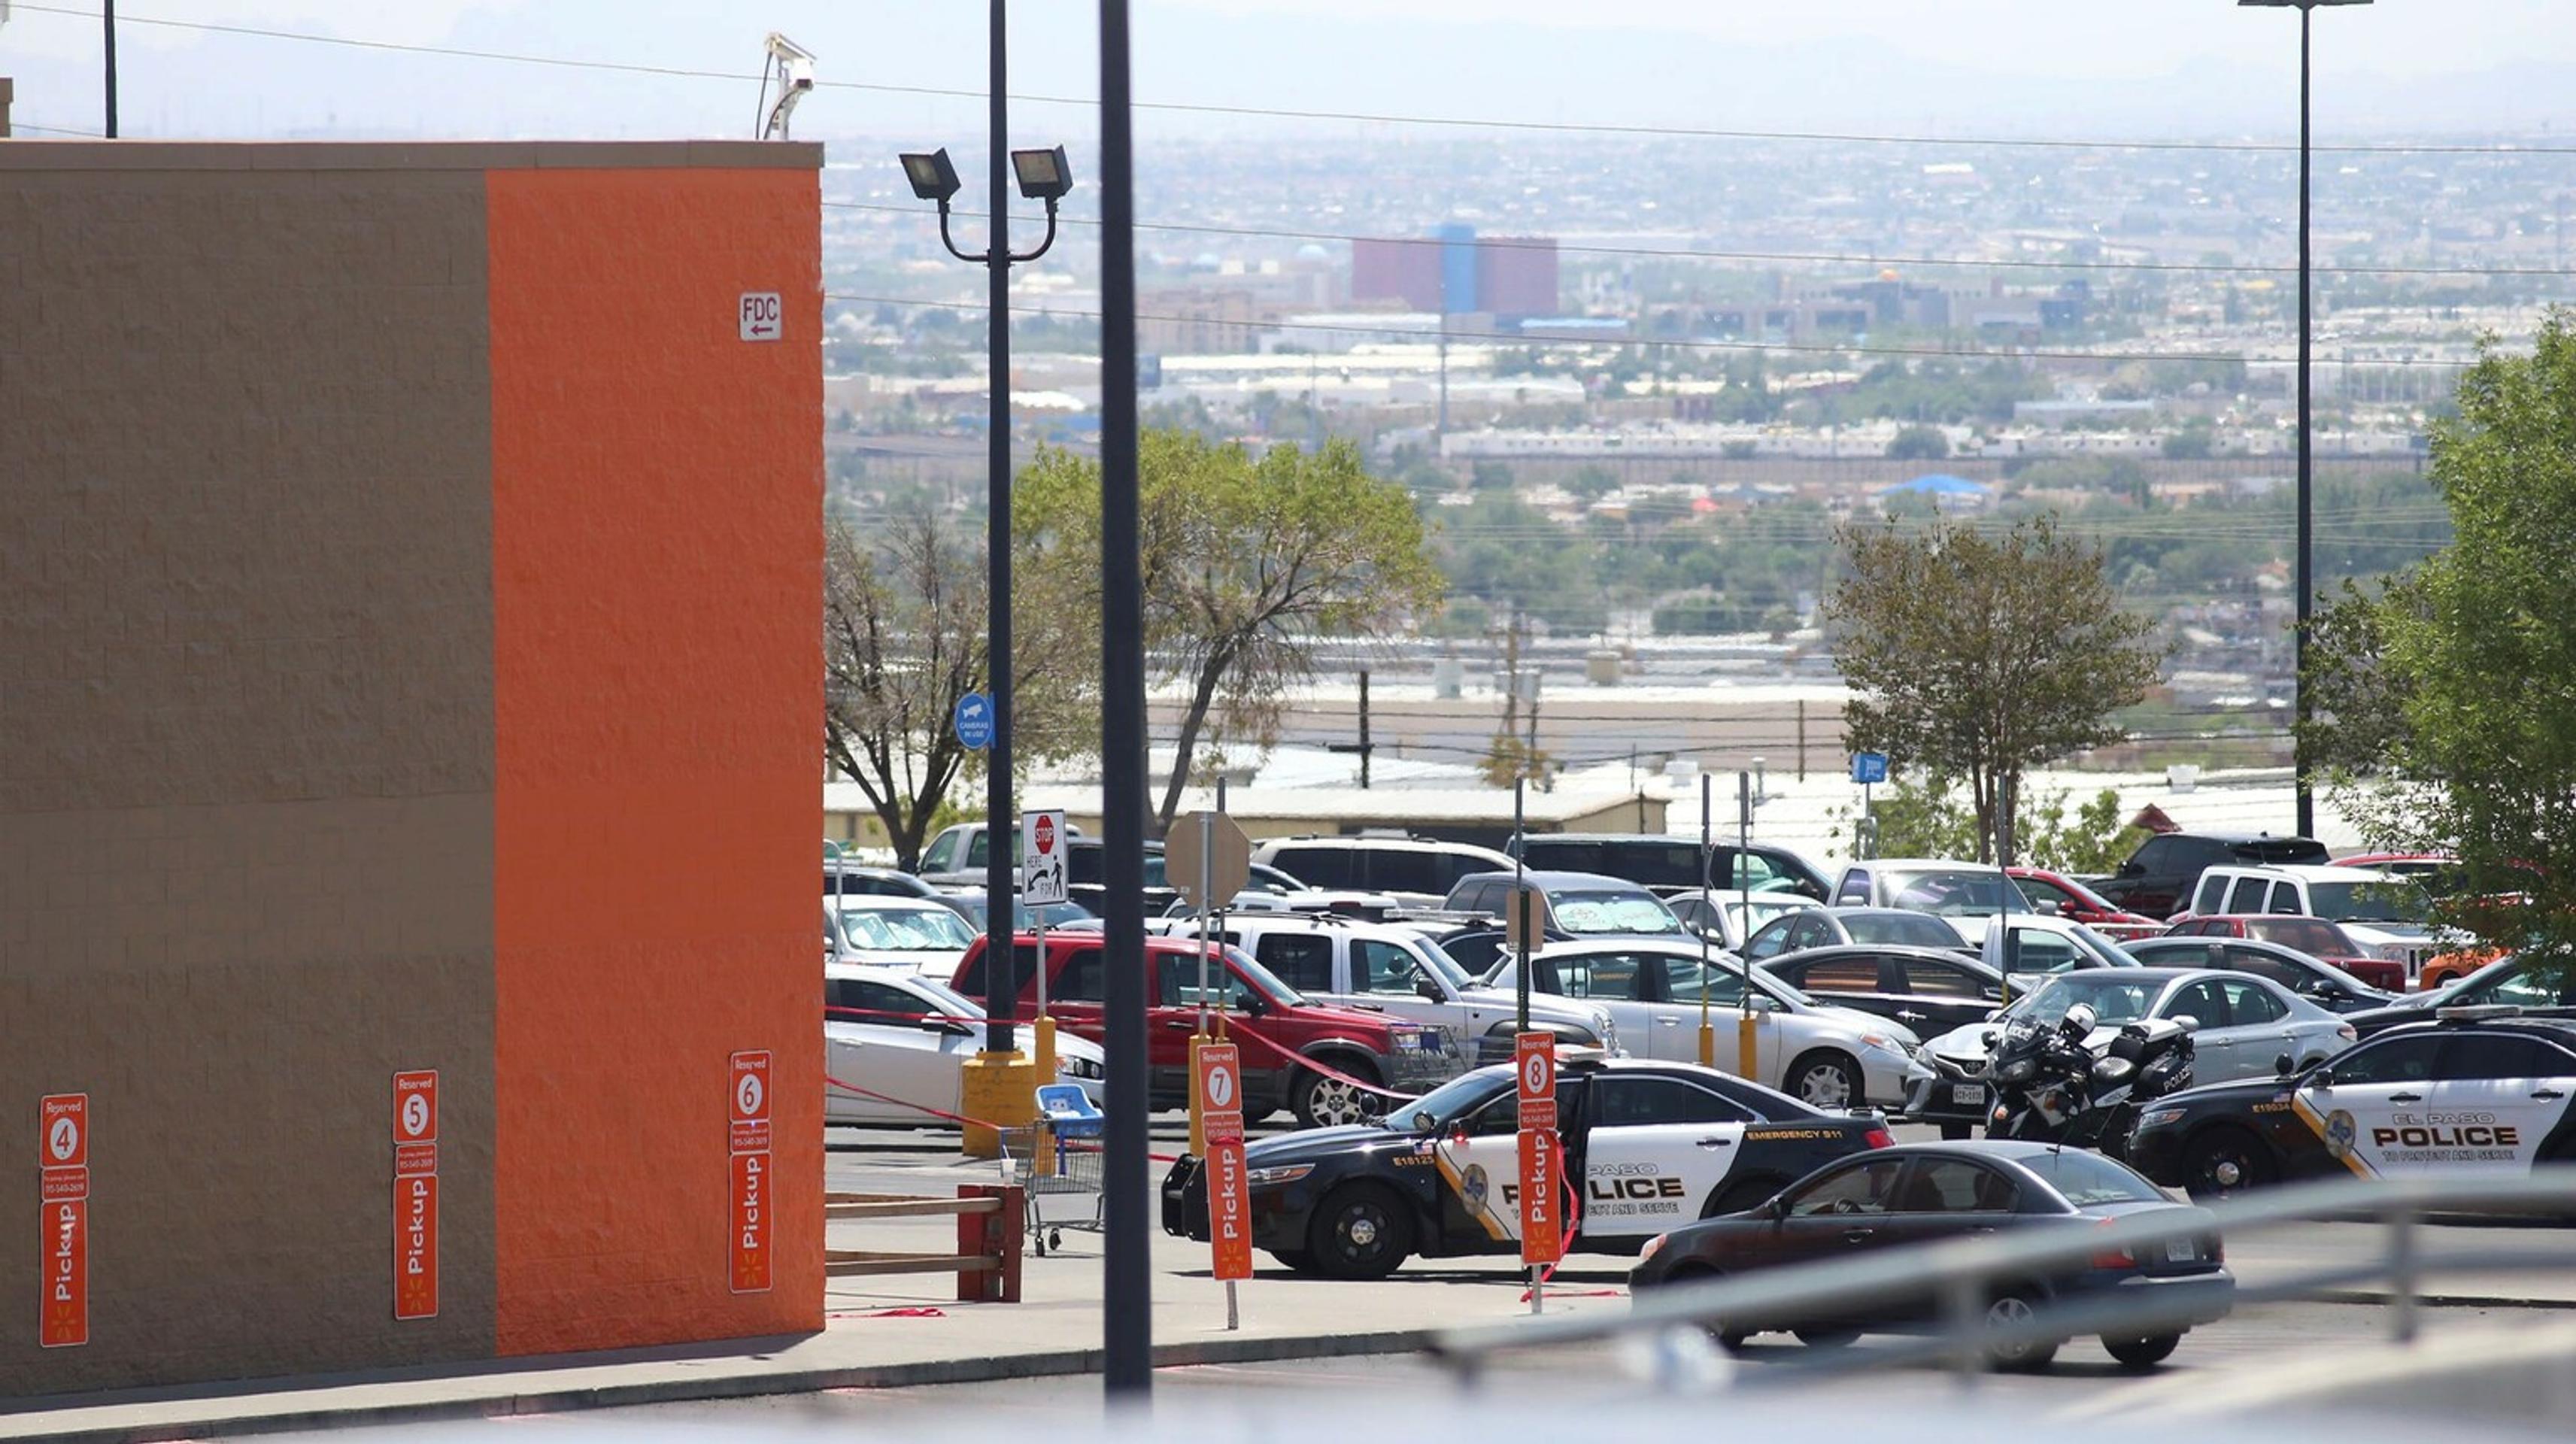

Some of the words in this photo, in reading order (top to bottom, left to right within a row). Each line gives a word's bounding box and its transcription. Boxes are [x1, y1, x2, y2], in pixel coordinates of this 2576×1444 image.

[743, 296, 778, 322] FDC
[959, 721, 989, 730] CAMERAS
[1036, 827, 1053, 842] STOP
[1026, 855, 1042, 868] HERE
[1040, 881, 1053, 895] FOR
[1521, 1039, 1550, 1049] Reserved
[735, 1057, 766, 1069] Reserved
[1203, 1051, 1234, 1062] Reserved
[1531, 1060, 1541, 1086] 8
[399, 1077, 432, 1090] Reserved
[1214, 1072, 1225, 1099] 7
[744, 1081, 754, 1107] 6
[47, 1101, 81, 1115] Reserved
[410, 1101, 420, 1127] 5
[2392, 1114, 2423, 1125] EL
[2428, 1112, 2496, 1125] PASO
[56, 1125, 70, 1152] 4
[1746, 1130, 1820, 1140] EMERGENCY
[1822, 1130, 1843, 1139] 911
[2372, 1127, 2520, 1147] POLICE
[2400, 1149, 2451, 1162] PROTECT
[1531, 1134, 1549, 1223] Pickup
[1221, 1148, 1239, 1239] Pickup
[742, 1157, 762, 1248] Pickup
[1639, 1202, 1680, 1215] SERVE
[408, 1179, 429, 1274] Pickup
[55, 1205, 77, 1301] Pickup
